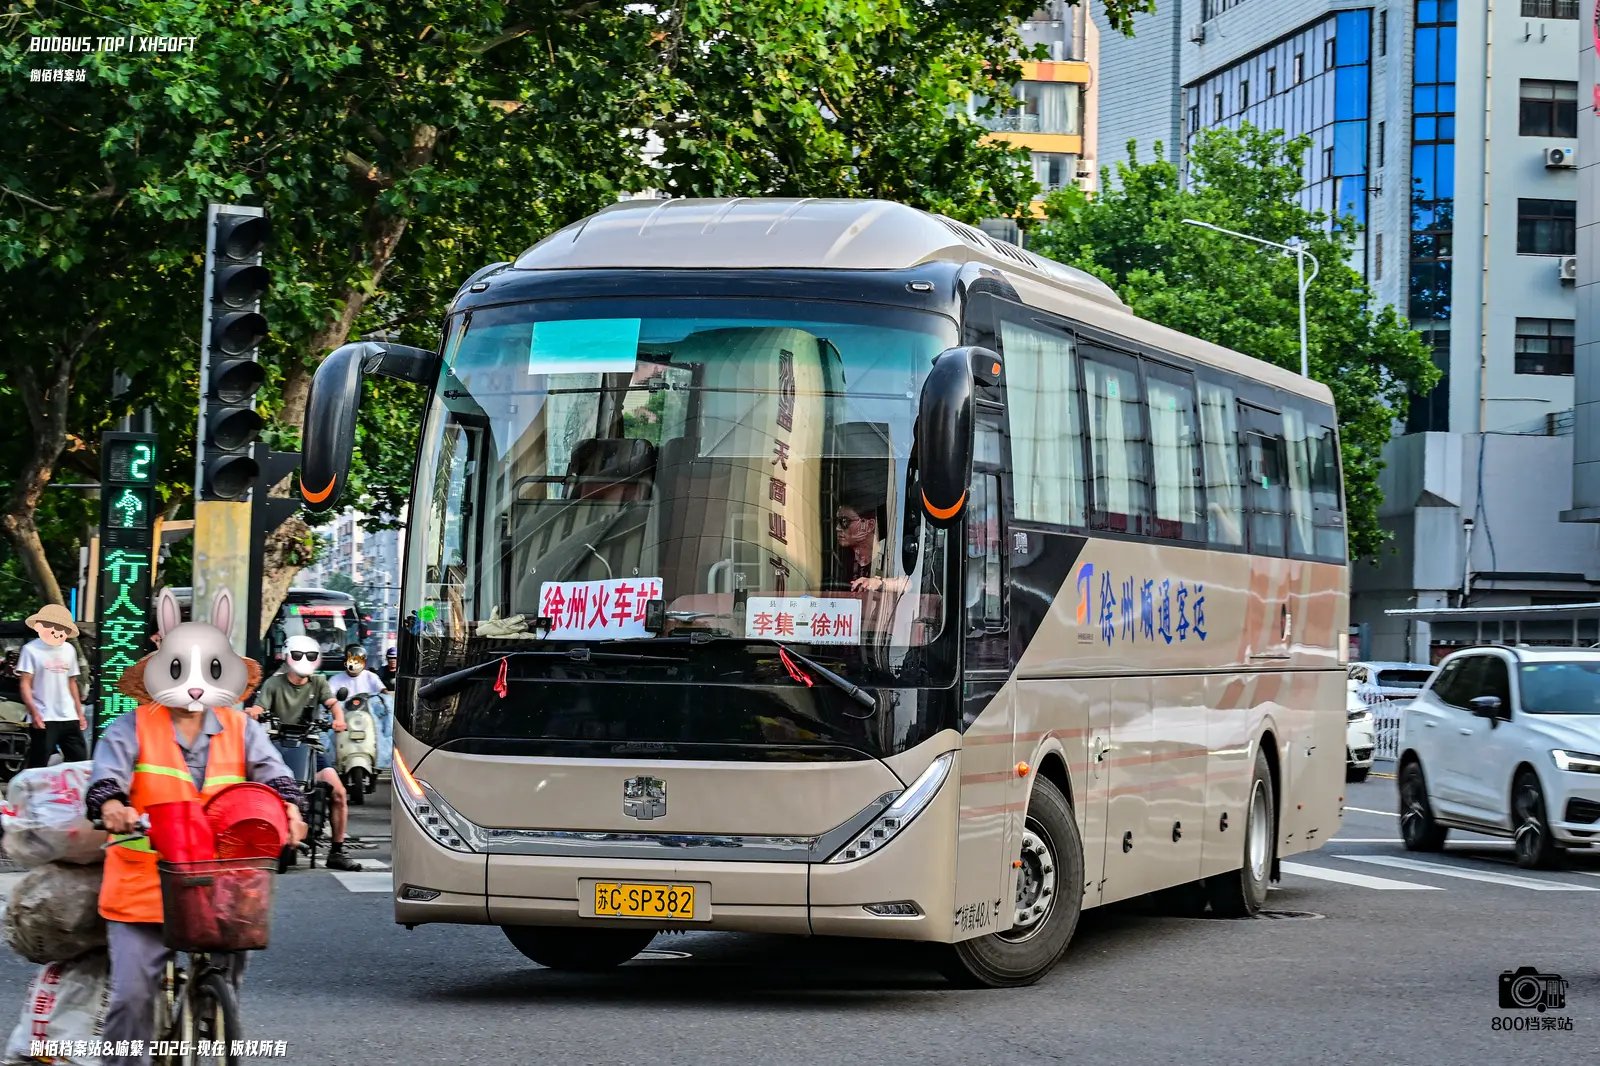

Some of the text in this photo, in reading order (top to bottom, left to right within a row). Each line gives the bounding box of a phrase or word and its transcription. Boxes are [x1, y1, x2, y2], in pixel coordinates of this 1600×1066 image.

[131, 444, 151, 479] 2
[543, 582, 659, 631] 徐州火车站
[1099, 570, 1207, 647] 徐州顺通客运
